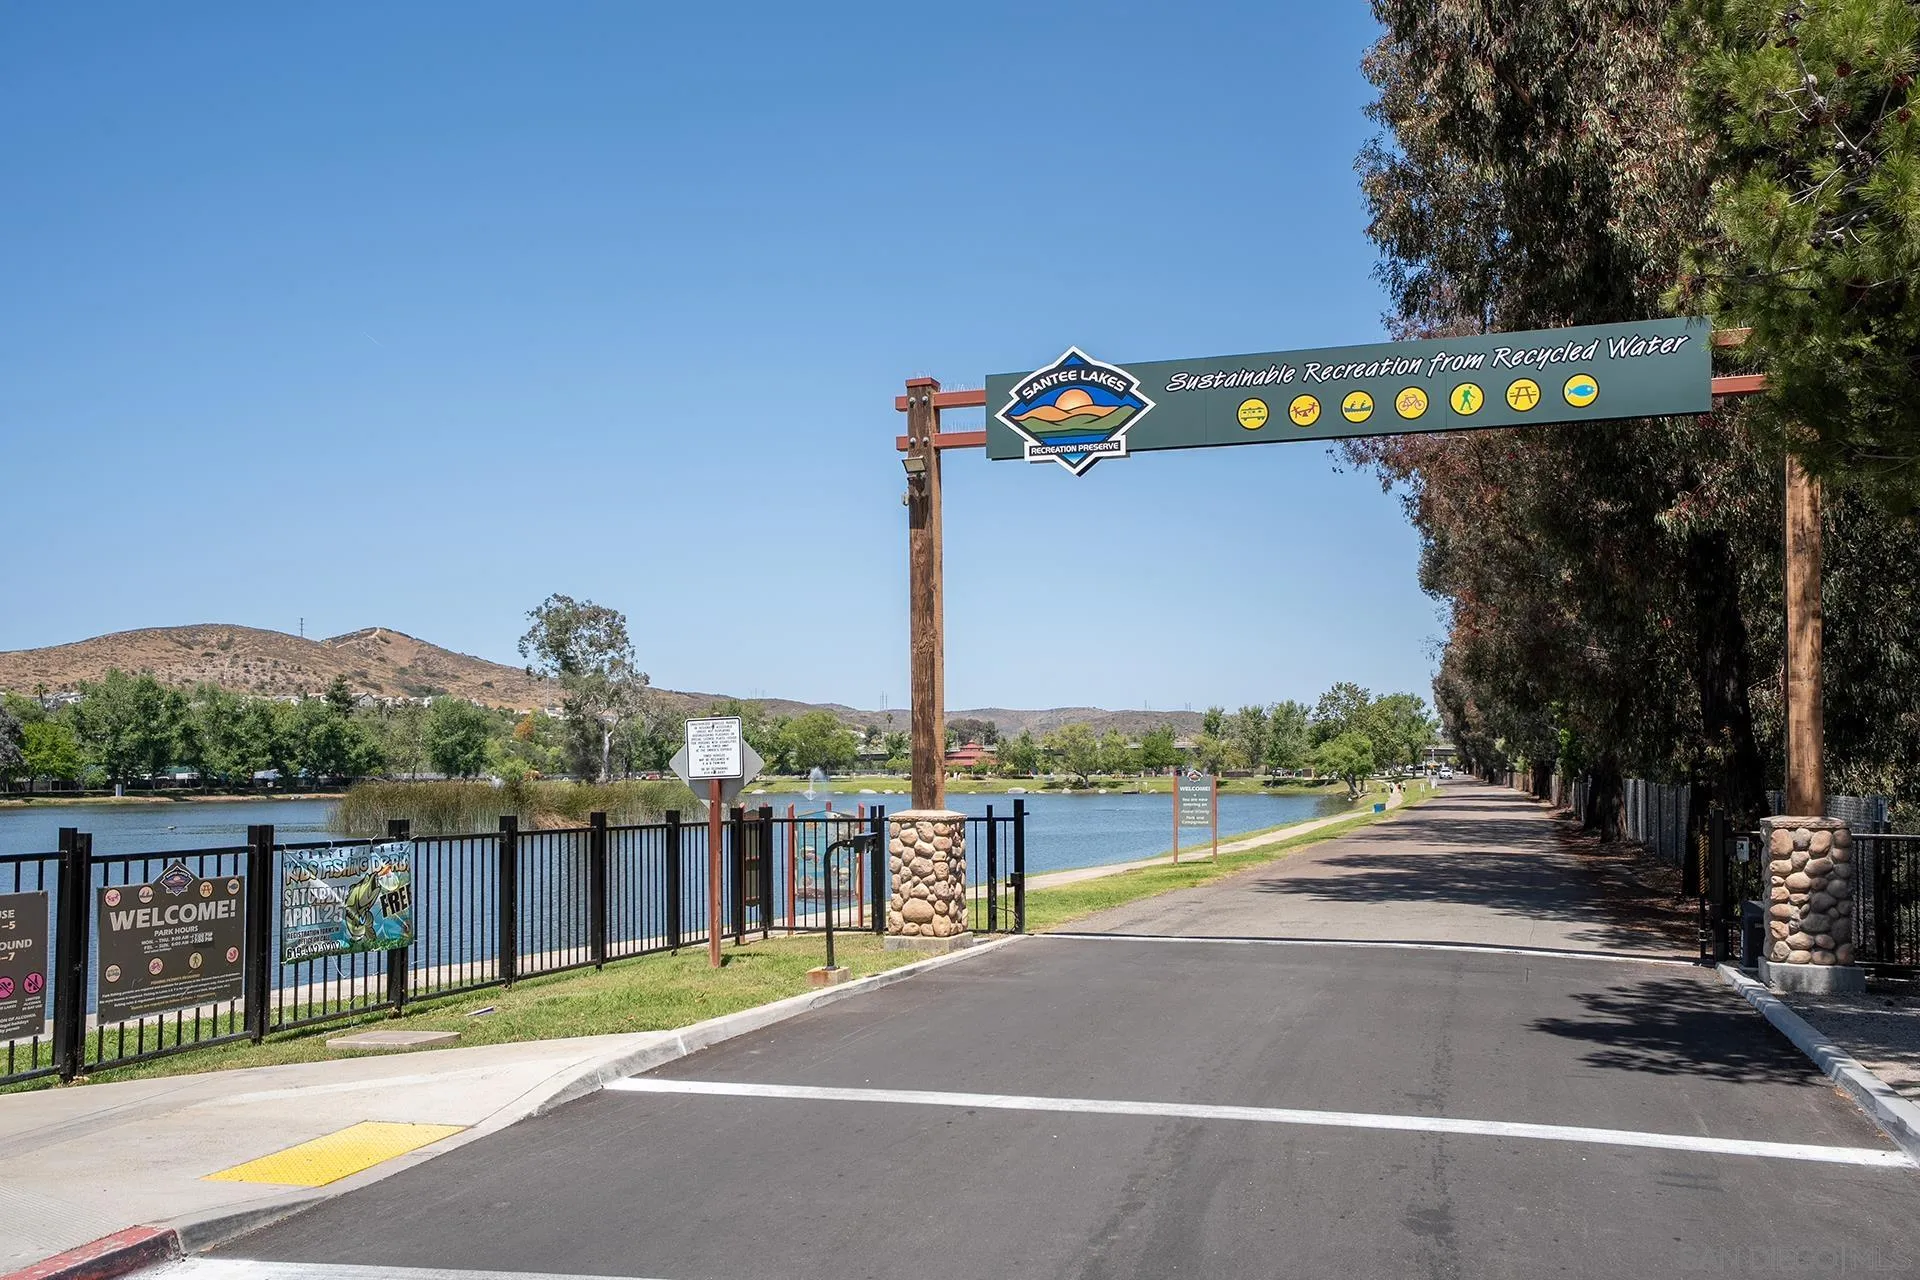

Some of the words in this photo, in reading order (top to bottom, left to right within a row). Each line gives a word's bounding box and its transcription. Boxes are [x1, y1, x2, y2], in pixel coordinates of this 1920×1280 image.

[1166, 364, 1295, 393] Sustainable
[1303, 353, 1423, 383] Recreation
[1427, 350, 1483, 377] from
[1493, 339, 1599, 372] Recycled
[1608, 333, 1690, 359] Water
[1022, 369, 1077, 400] SANTEE
[1080, 370, 1127, 393] LAKES
[1031, 444, 1077, 455] RECREATION
[1078, 442, 1120, 452] PRESERVE
[0, 909, 15, 919] SE
[109, 899, 236, 931] WELCOME!
[284, 905, 323, 928] APRIL
[323, 903, 343, 923] 25
[154, 928, 174, 937] PARK
[175, 925, 199, 935] HOURS
